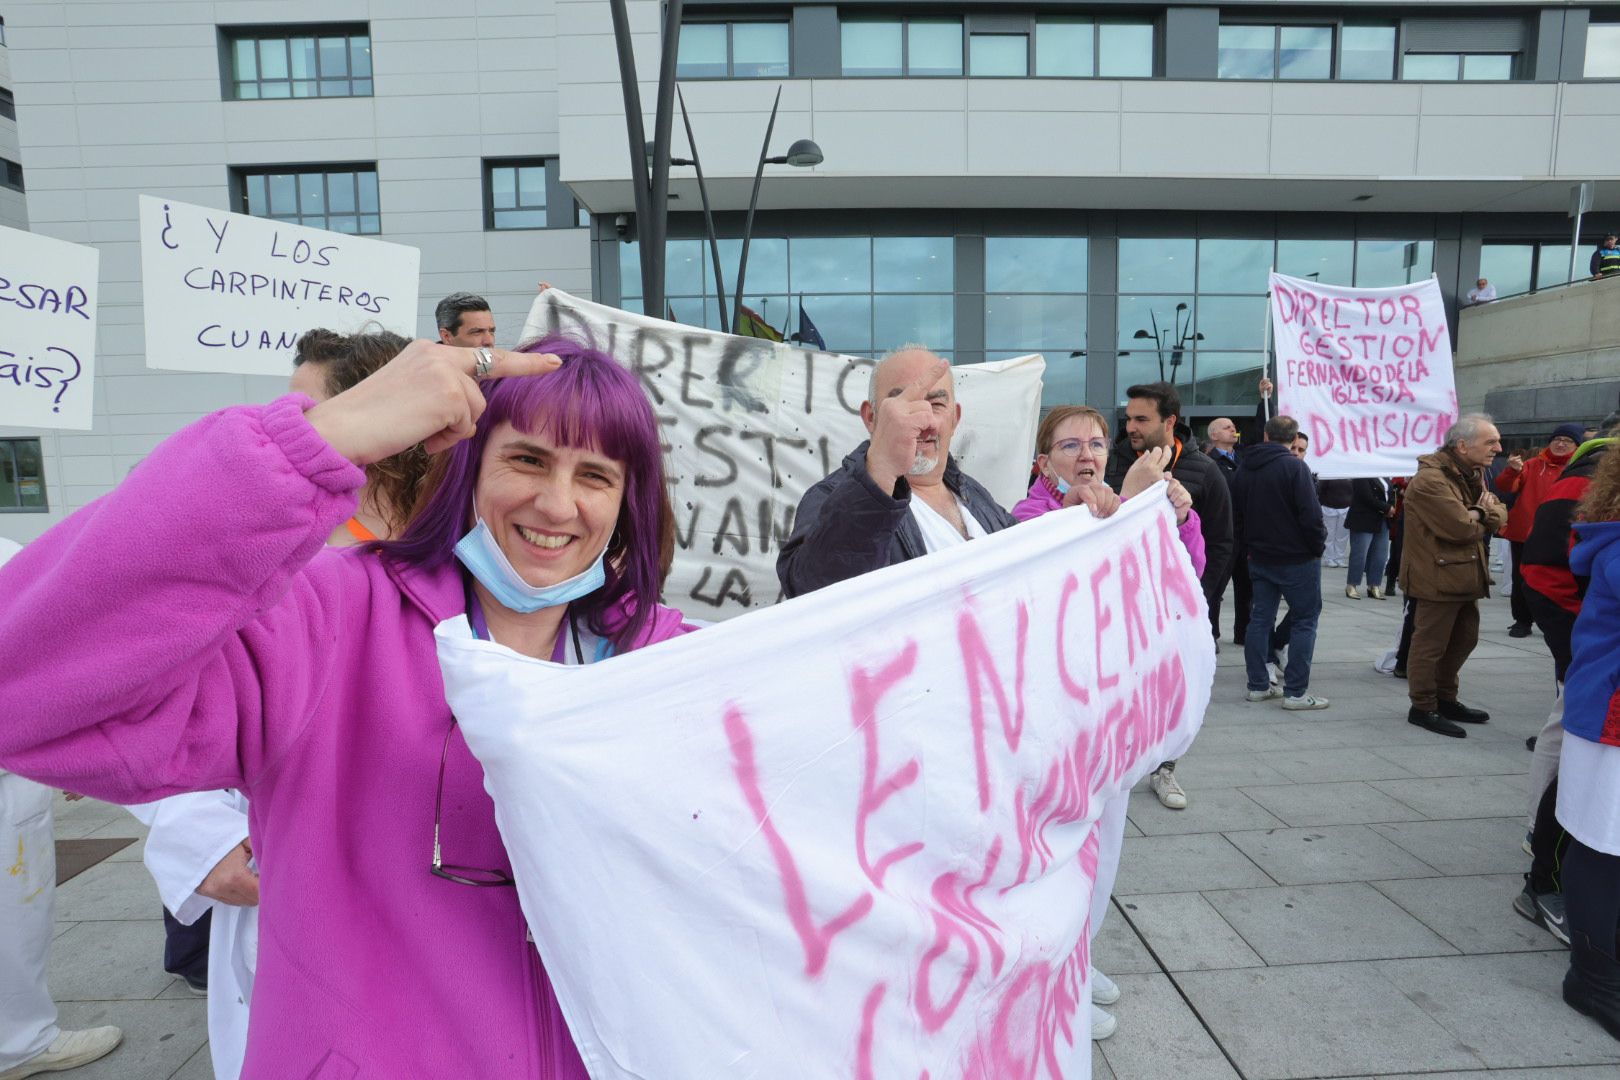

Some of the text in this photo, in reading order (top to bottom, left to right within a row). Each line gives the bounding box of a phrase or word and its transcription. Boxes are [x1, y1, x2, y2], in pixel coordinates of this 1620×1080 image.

[270, 231, 340, 267] LOS
[184, 266, 391, 314] CARPINTEROS
[1274, 285, 1423, 331] DIRECTOR
[197, 324, 298, 351] CUAN
[1299, 325, 1445, 360] GESTION
[0, 346, 82, 413] ais?
[1286, 359, 1383, 387] FERNANDO
[1331, 381, 1417, 405] IGLESIA
[1310, 412, 1452, 457] DIMISION
